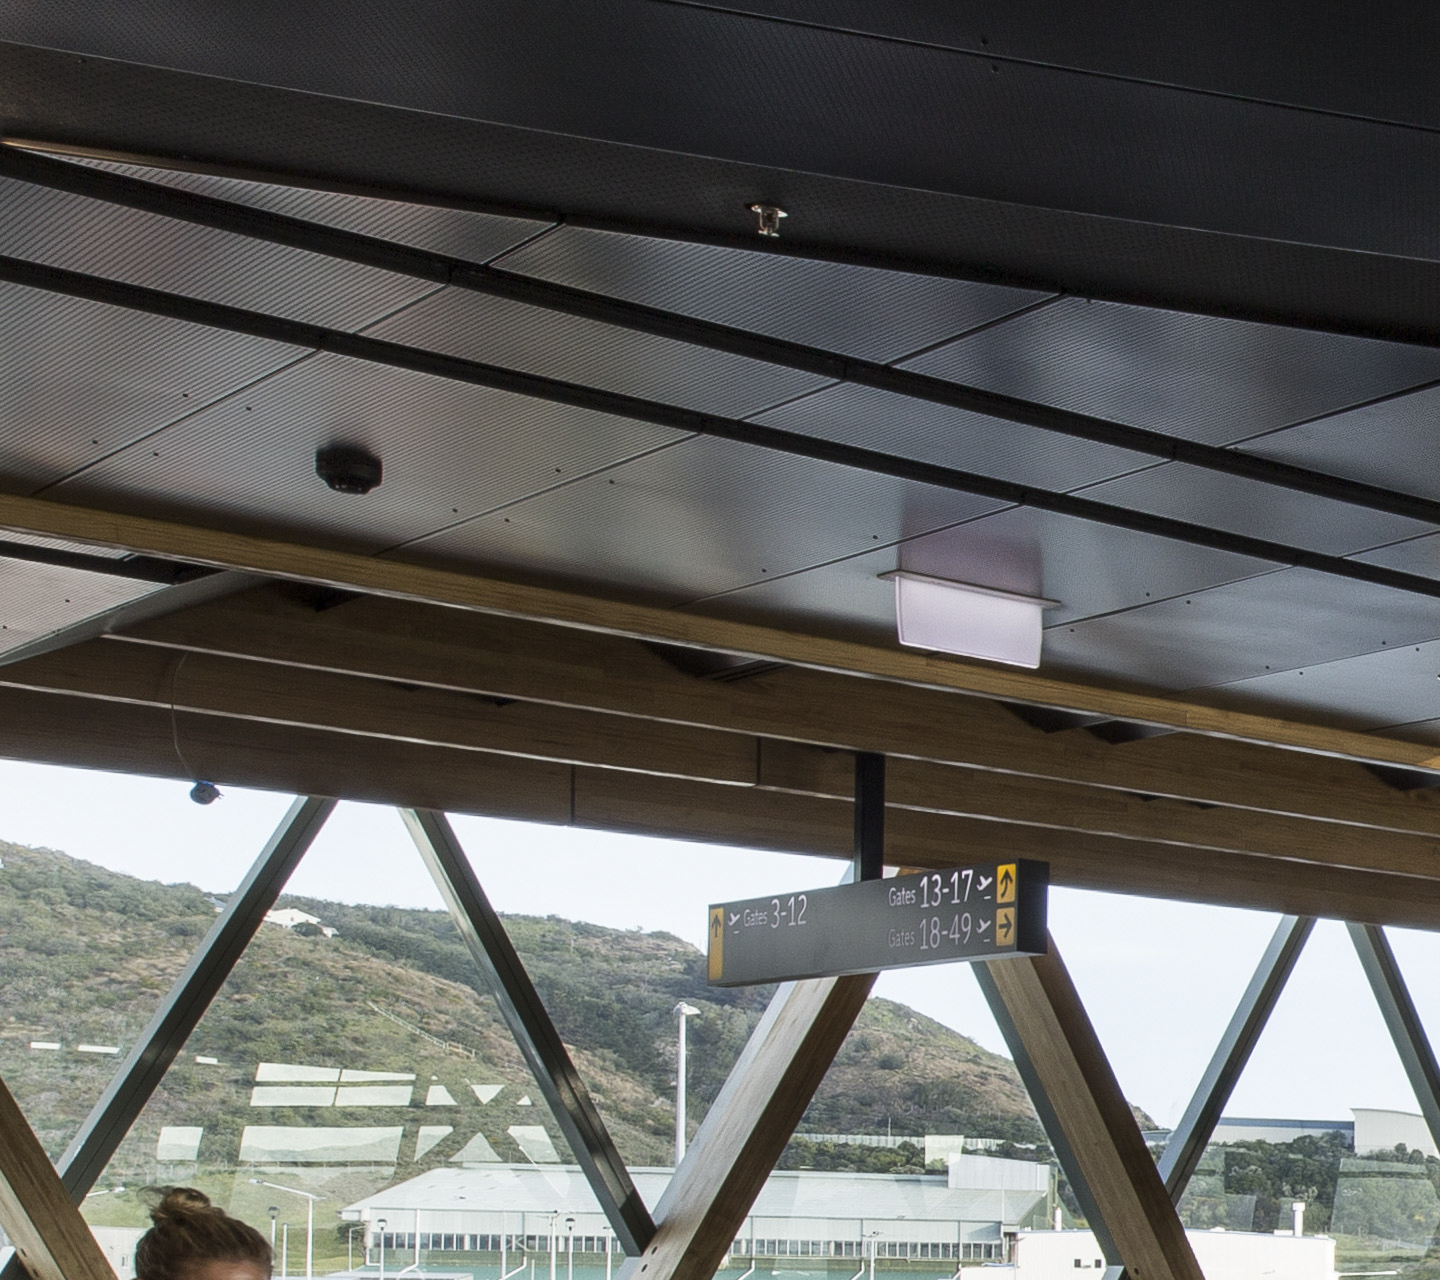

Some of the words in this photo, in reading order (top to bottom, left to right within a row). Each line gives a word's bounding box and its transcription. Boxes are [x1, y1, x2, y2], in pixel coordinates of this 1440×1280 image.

[888, 886, 916, 908] Gates
[919, 869, 974, 909] 13-17
[743, 908, 768, 928] Gates
[770, 894, 808, 928] 3-12
[887, 927, 915, 949] Gates
[918, 912, 972, 951] 18-49
